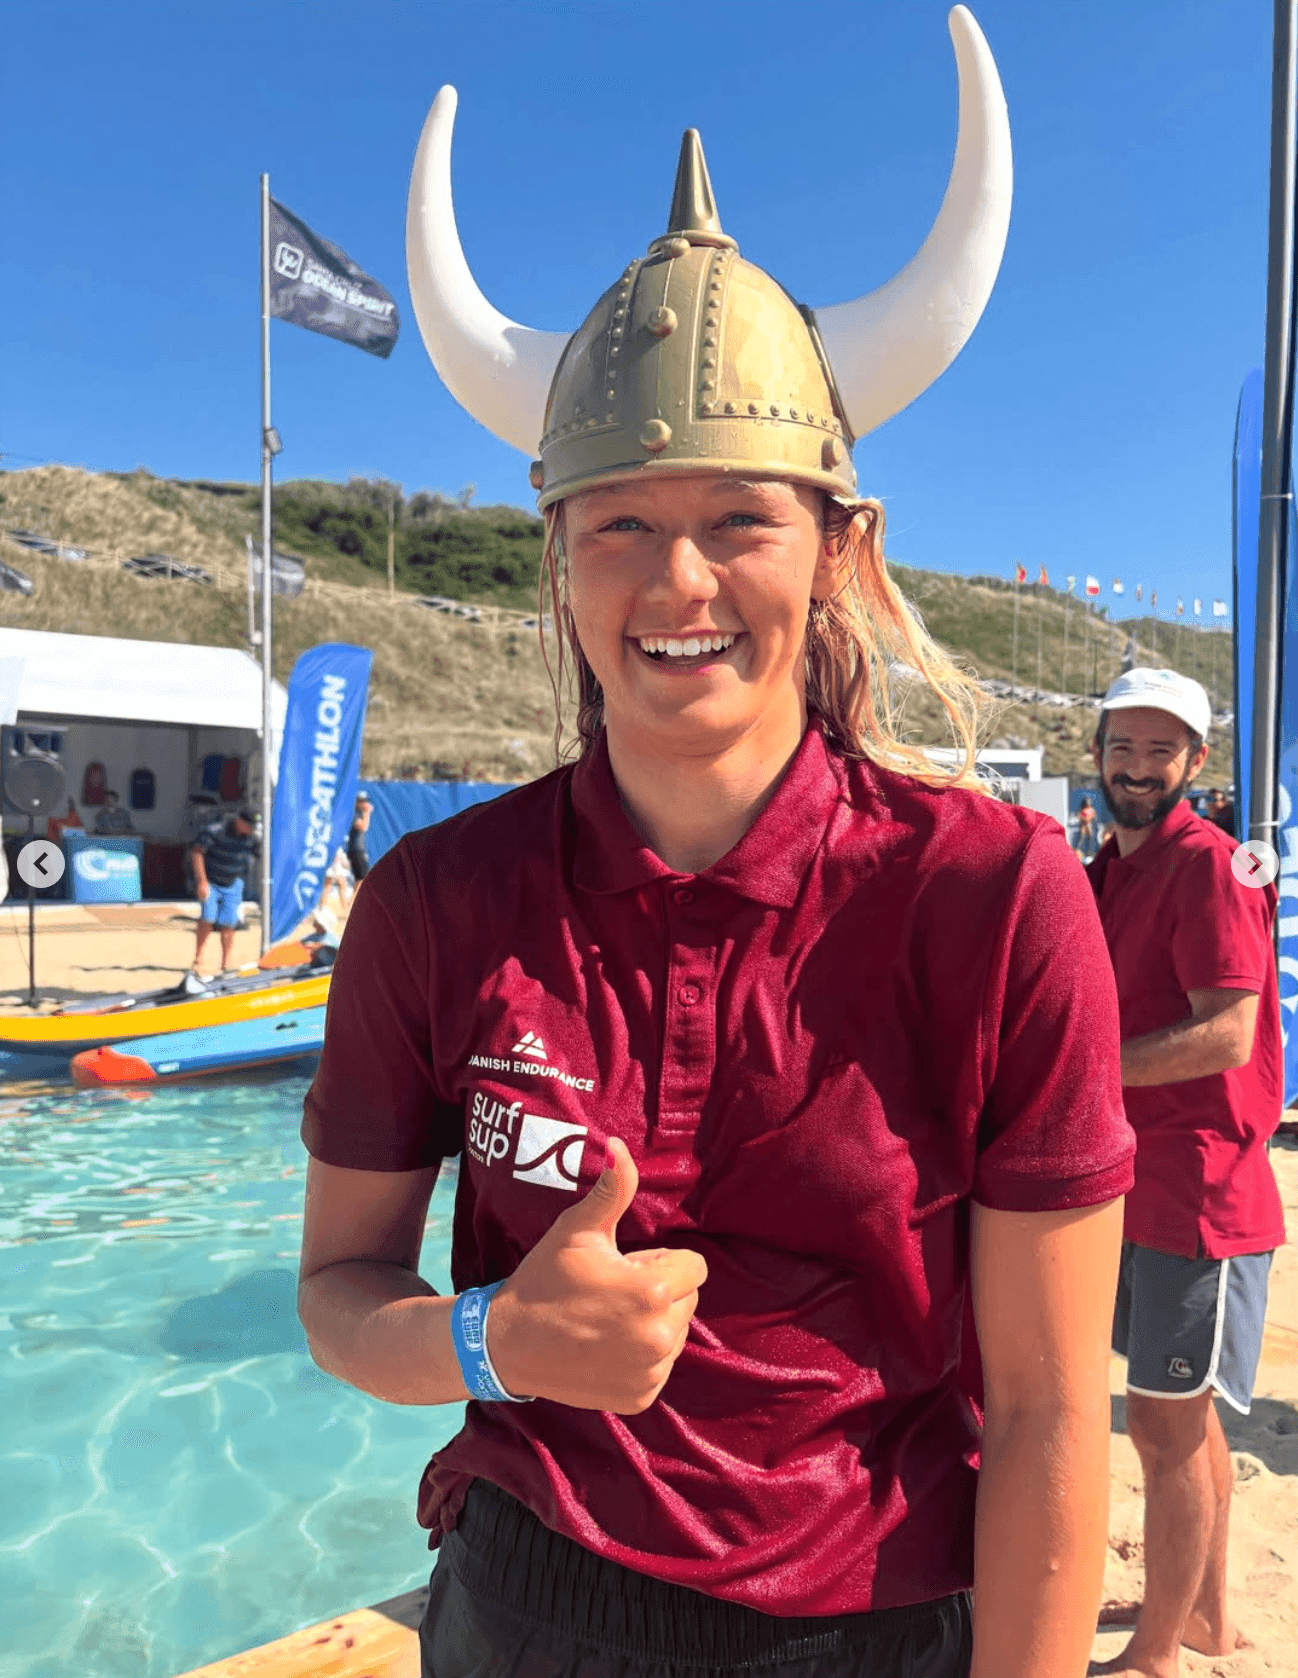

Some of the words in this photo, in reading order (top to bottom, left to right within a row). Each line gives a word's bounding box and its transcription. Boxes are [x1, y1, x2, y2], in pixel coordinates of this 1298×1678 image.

[303, 674, 347, 869] DECATHLON
[468, 1055, 511, 1072] ANISH
[513, 1061, 595, 1092] ENDURANCE
[472, 1092, 523, 1134] surf
[468, 1118, 510, 1167] sup
